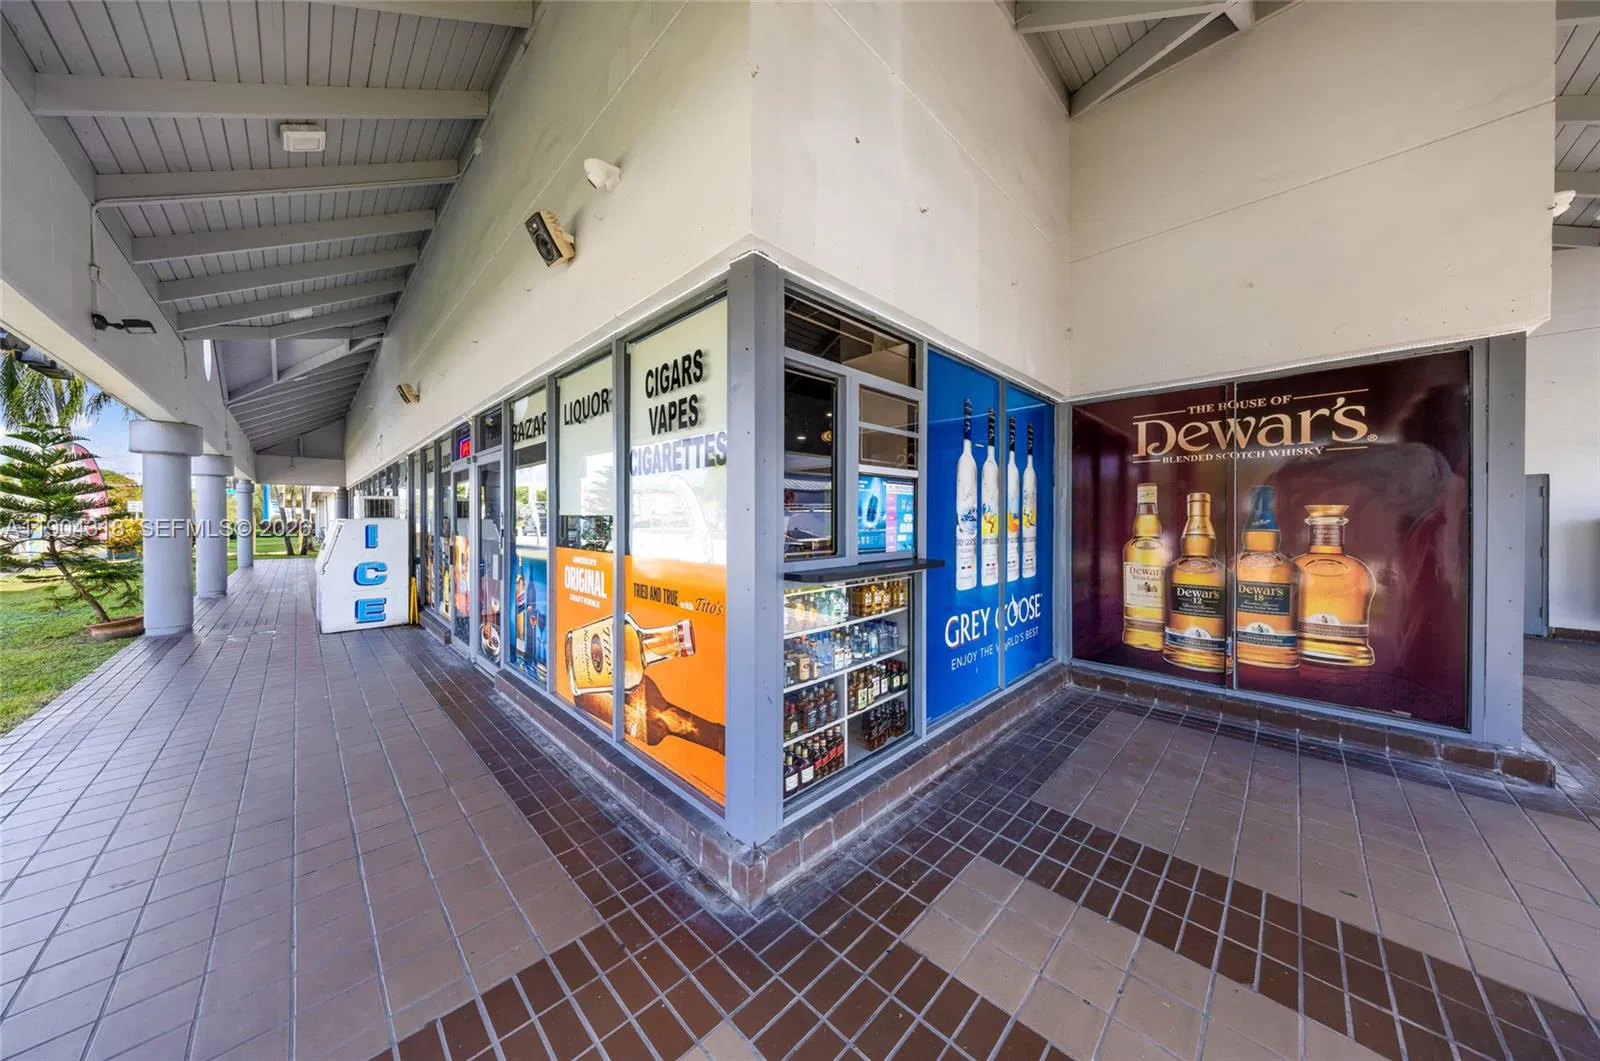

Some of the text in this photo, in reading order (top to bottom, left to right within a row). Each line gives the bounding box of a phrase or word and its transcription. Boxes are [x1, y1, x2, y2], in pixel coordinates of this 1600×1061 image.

[645, 349, 704, 399] CIGARS
[564, 388, 609, 426] LIQUOR
[649, 394, 699, 436] VAPES
[1187, 394, 1292, 415] THE HOUSE OF
[1132, 397, 1369, 457] Dewar's
[629, 431, 727, 477] CIGARETTES
[1162, 446, 1325, 464] BLENDED SCOTCH WHISKY
[353, 524, 388, 624] ICE
[564, 565, 608, 600] ORIGINAL
[1177, 587, 1220, 599] Dewar's
[1238, 584, 1284, 596] Dewar's
[633, 583, 648, 599] TRIED
[649, 586, 662, 602] AND
[662, 588, 679, 606] TRUE
[695, 597, 722, 616] Tito's
[1193, 597, 1202, 605] 12
[944, 607, 991, 648] GREY
[951, 626, 1039, 671] ENJOY THE RLD'S BEST
